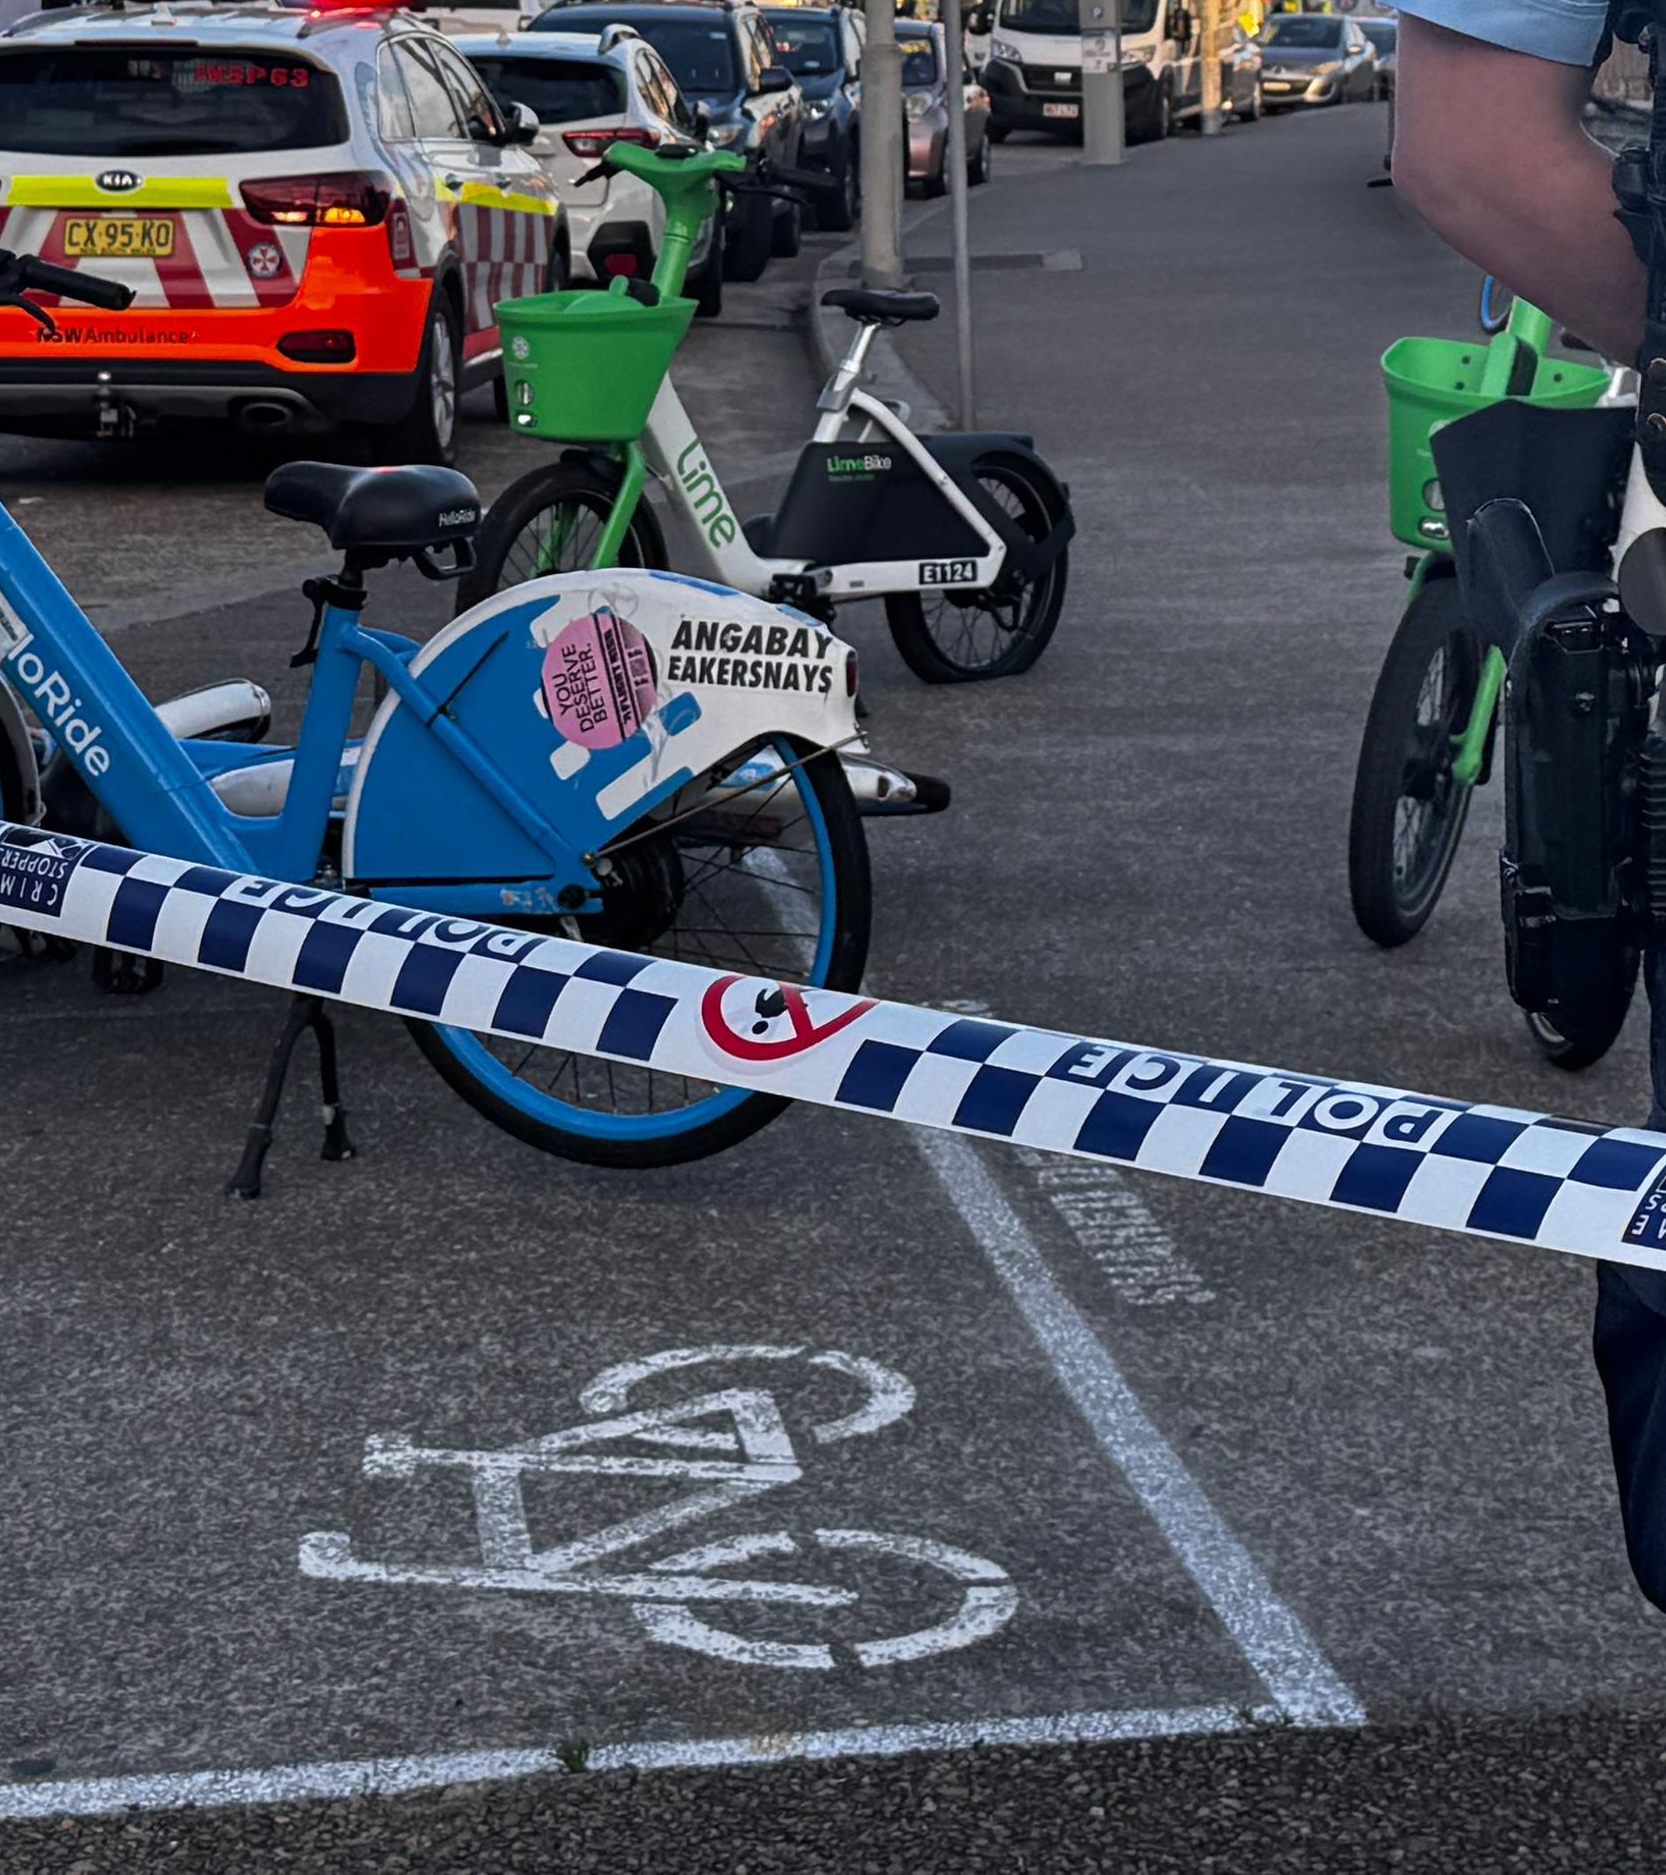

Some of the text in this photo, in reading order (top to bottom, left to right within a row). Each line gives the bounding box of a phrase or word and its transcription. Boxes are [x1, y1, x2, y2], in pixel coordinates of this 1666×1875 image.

[102, 176, 133, 186] KIA
[85, 327, 189, 344] Ambulance
[827, 455, 892, 473] LimeBike
[677, 437, 736, 549] Lime
[923, 563, 974, 583] E1124
[671, 620, 833, 660] ANGABAY
[552, 672, 573, 716] YOU
[561, 643, 593, 733] DESERVE
[582, 642, 608, 724] BETTER.
[667, 655, 833, 694] EAKERSNAYS
[1066, 1044, 1445, 1145] POLICE
